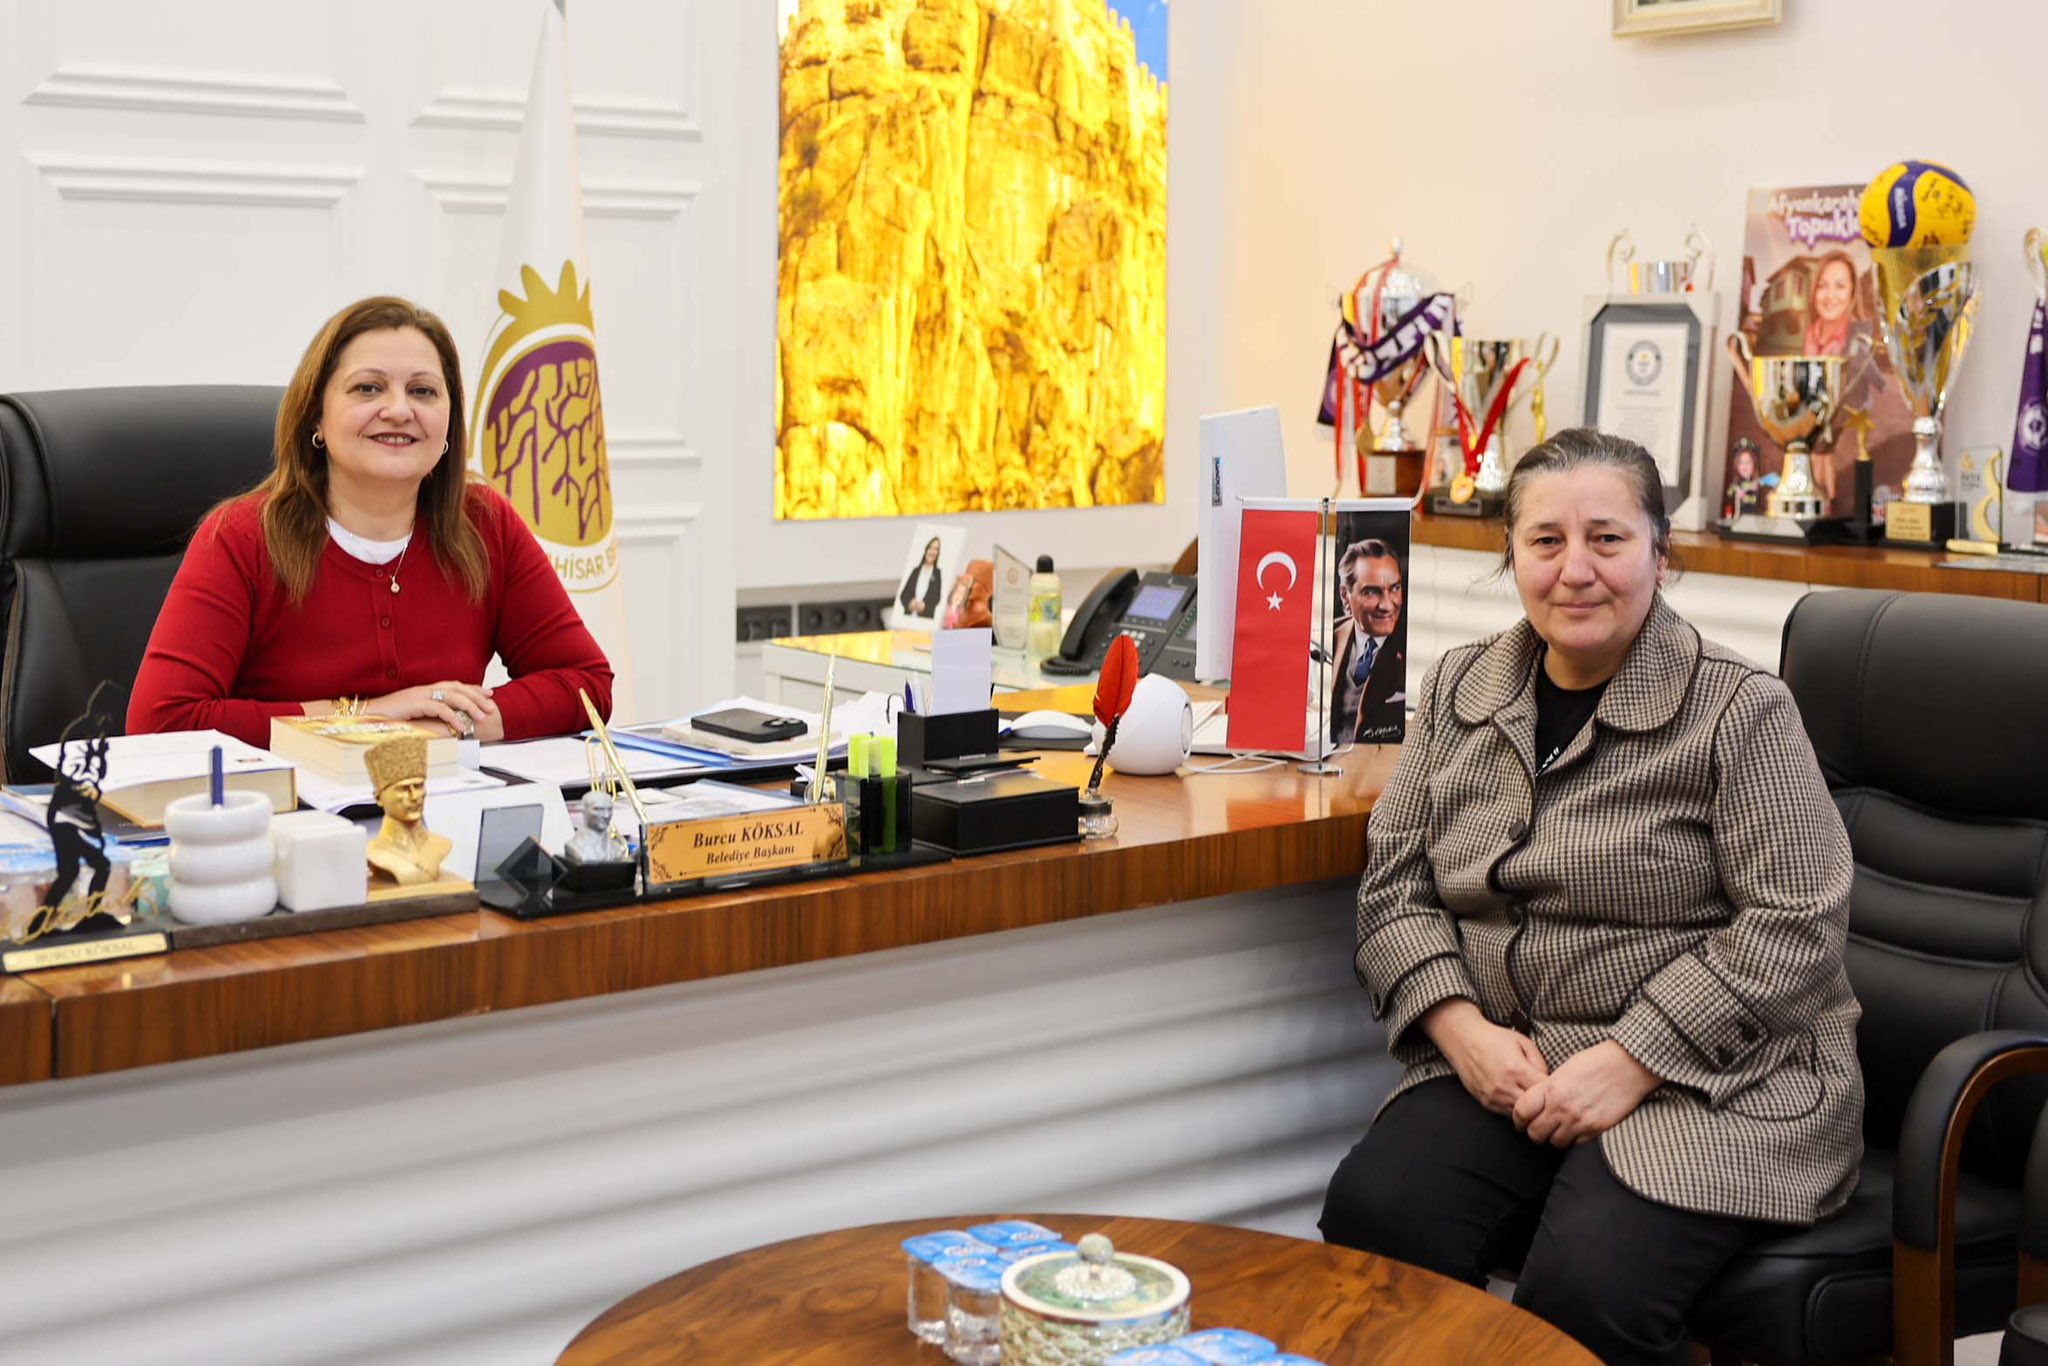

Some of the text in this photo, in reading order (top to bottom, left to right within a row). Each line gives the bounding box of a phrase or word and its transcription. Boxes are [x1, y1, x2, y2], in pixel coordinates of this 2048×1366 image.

[548, 552, 604, 580] HİSAR
[693, 820, 804, 849] Burcu KÖKSAL
[706, 844, 795, 865] Belediye Başkanı
